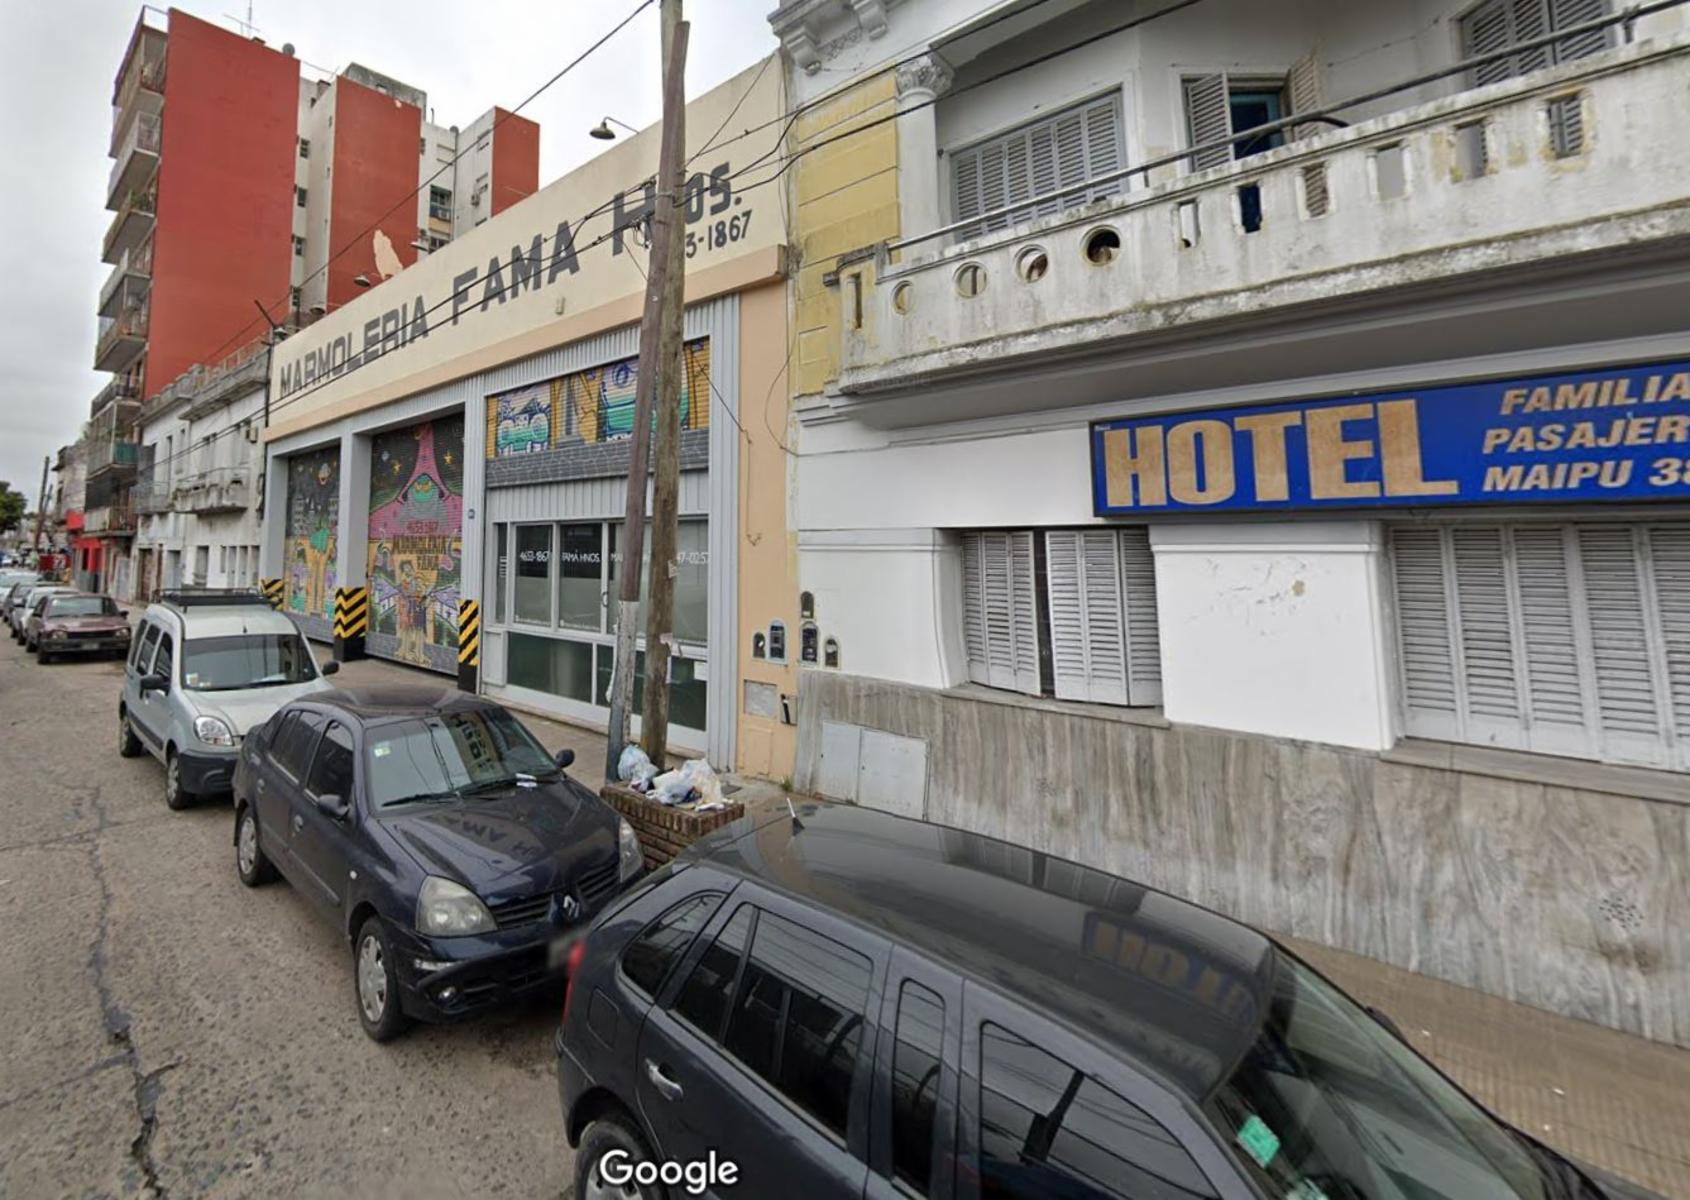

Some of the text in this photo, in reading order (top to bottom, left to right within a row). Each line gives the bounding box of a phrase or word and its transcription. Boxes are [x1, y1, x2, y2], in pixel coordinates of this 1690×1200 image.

[280, 295, 428, 399] MARMOLERIA
[452, 220, 580, 326] FAMA
[1500, 372, 1690, 415] FAMILIA
[1104, 399, 1459, 508] HOTEL
[1482, 415, 1690, 454] PASAJER
[1482, 460, 1634, 492] MAIPU
